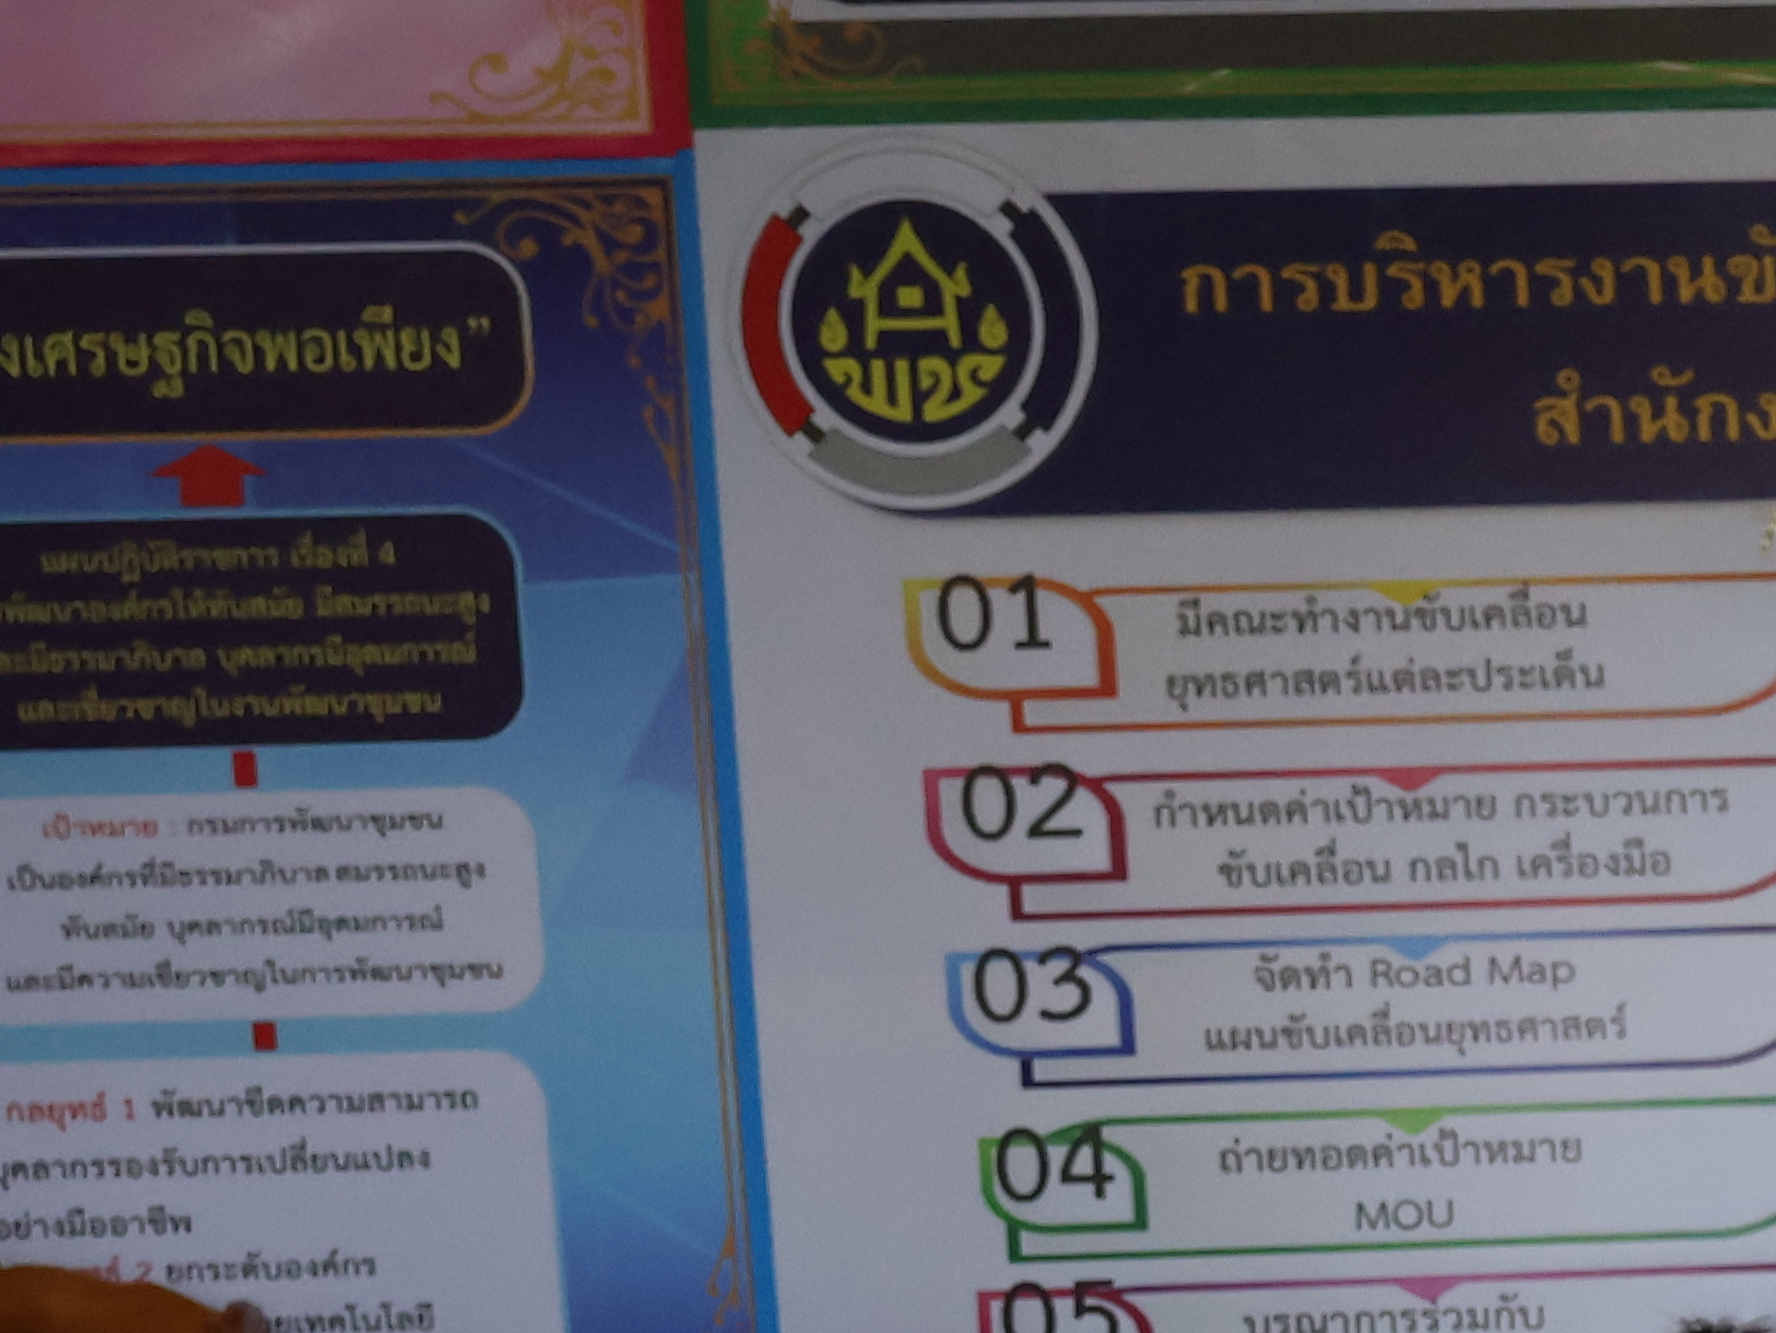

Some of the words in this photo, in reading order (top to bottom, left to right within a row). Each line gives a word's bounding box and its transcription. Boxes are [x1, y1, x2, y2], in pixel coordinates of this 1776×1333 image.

[0, 587, 304, 624] พัฒนาองค์กรให้ทันสมัย
[937, 572, 1053, 653] 01
[1174, 584, 1587, 638] มีคณะทำงานขับเคลื่อน
[1164, 654, 1606, 711] ยุทธศาสตร์แต่ละประเด็น
[960, 762, 1086, 841] 02
[1152, 782, 1498, 831] กำหนดค่าเป้าหมาย
[1513, 783, 1731, 821] กระบวนการ
[1217, 835, 1393, 888] ขับเคลื่อน
[1408, 840, 1501, 883] กลไก
[1514, 829, 1672, 880] เครื่องมือ
[973, 945, 1092, 1025] 03
[1252, 950, 1354, 994] จัดทำ
[1368, 954, 1473, 990] Road
[1486, 953, 1577, 994] Map
[1203, 1005, 1628, 1056] แผนขับเคลื่อนยุทธศาสตร์
[997, 1124, 1117, 1202] 04
[1217, 1126, 1583, 1176] ถ่ายทอดค่าเป้าหมาย
[1354, 1198, 1455, 1233] MOU
